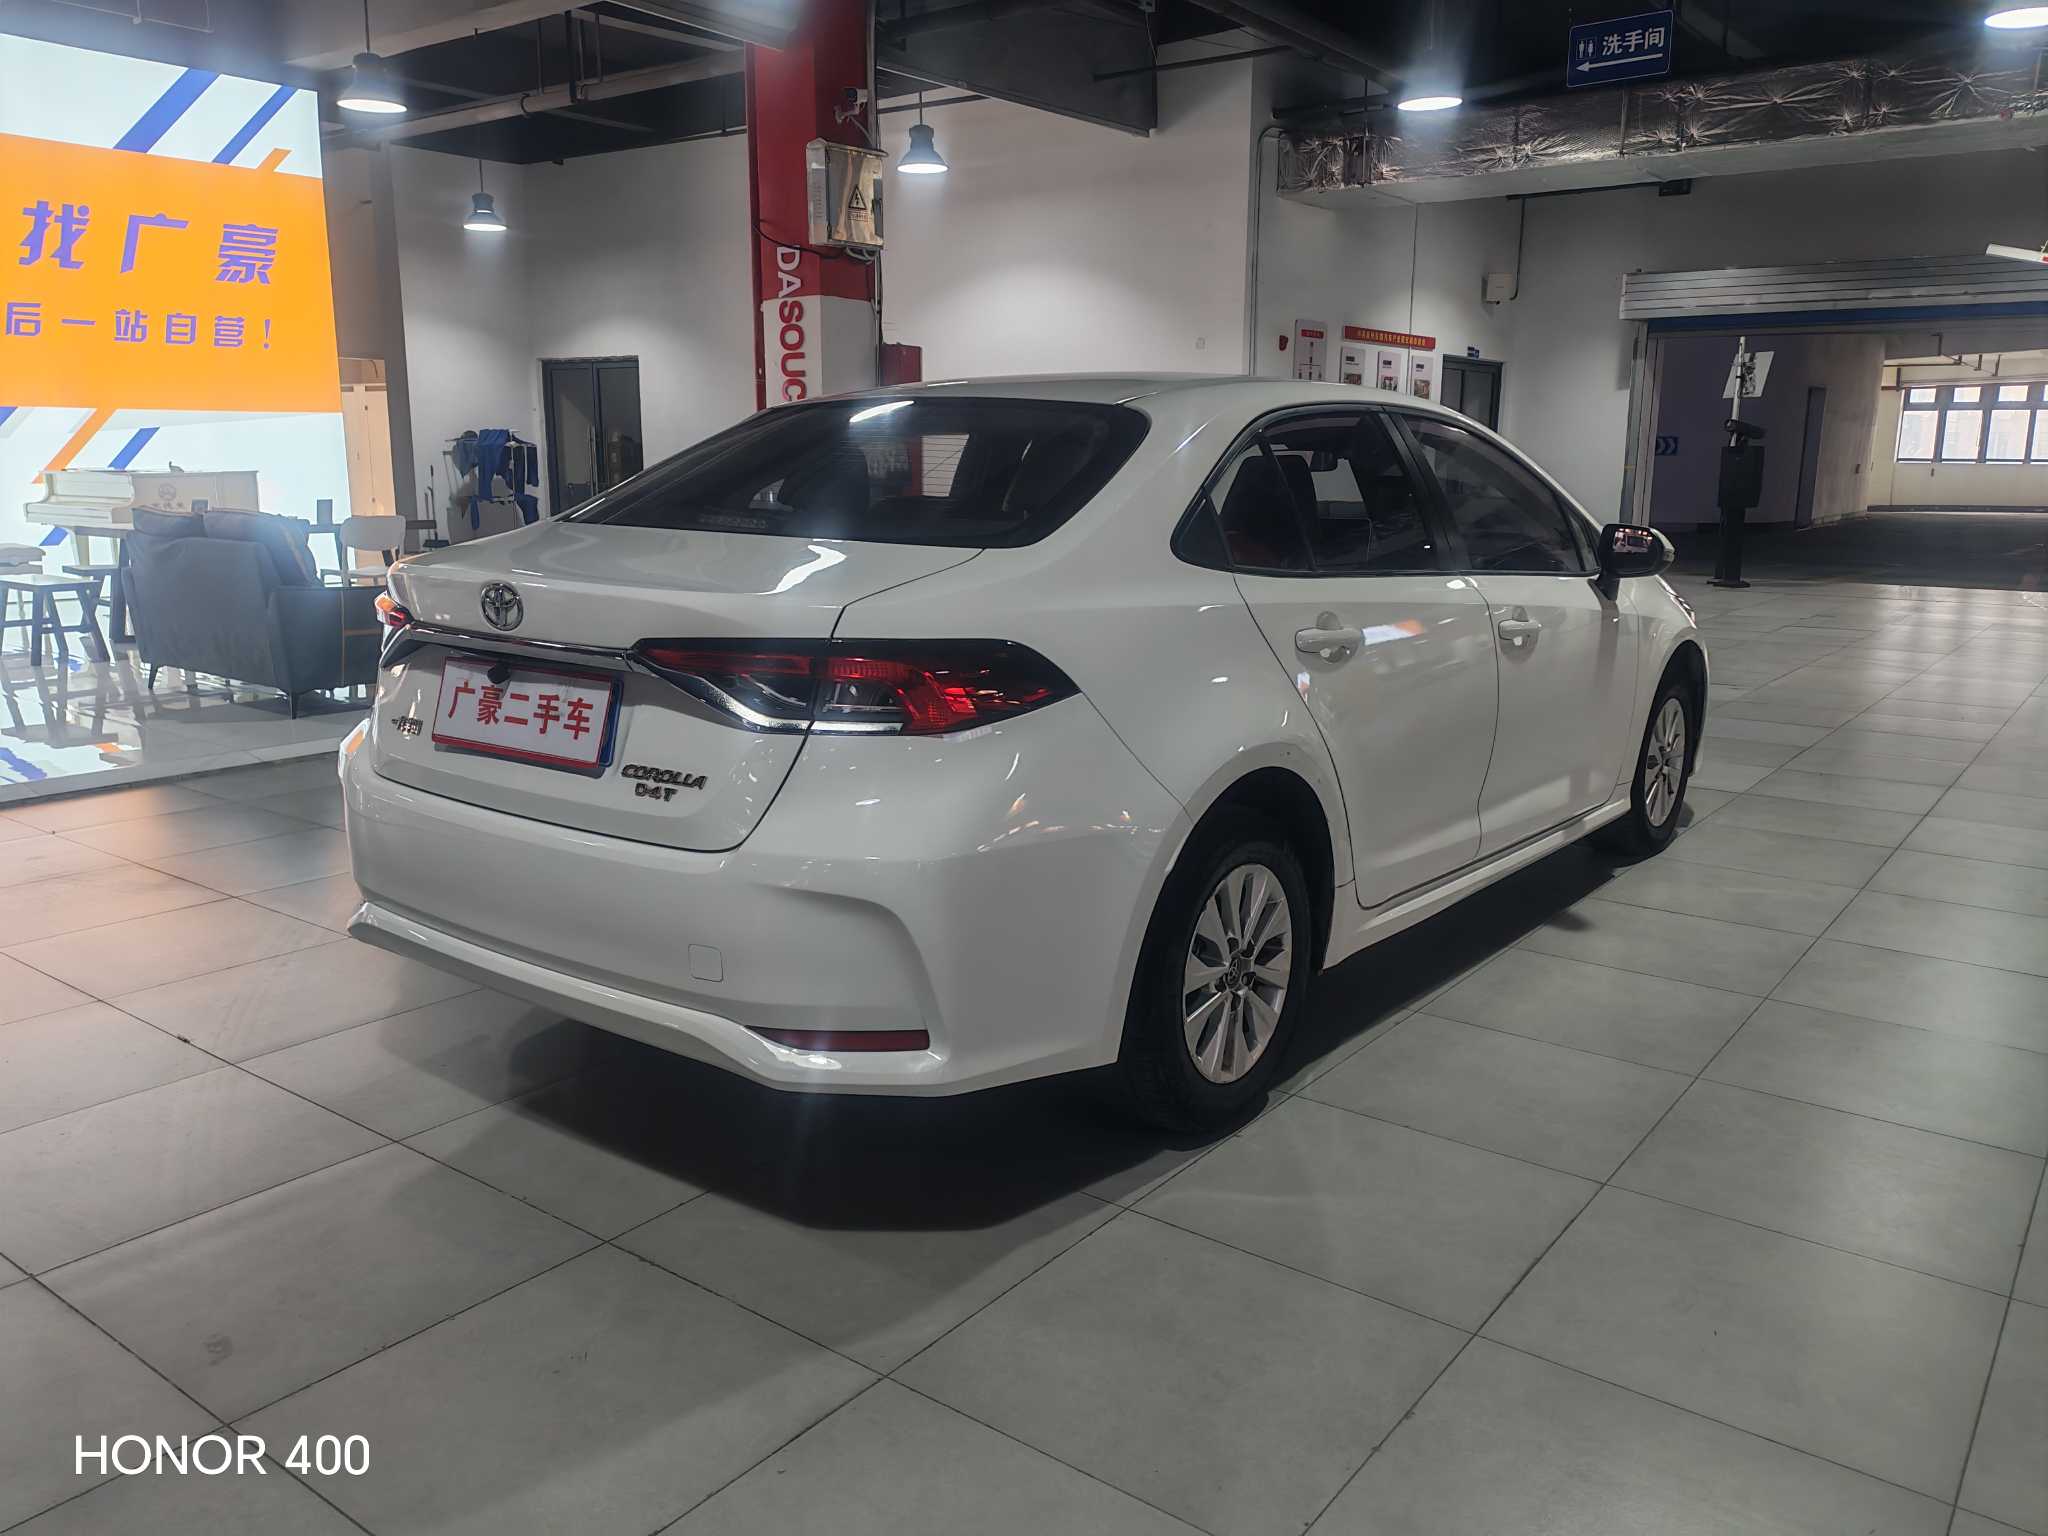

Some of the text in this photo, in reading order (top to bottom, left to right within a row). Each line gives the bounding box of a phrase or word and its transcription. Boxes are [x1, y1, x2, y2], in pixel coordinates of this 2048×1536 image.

[1602, 27, 1665, 56] 洗手间
[18, 200, 279, 285] 找广豪
[5, 302, 271, 350] 后一站自营!
[448, 680, 594, 741] 广豪二手车
[621, 764, 708, 790] COROLLA
[635, 782, 678, 802] D4T
